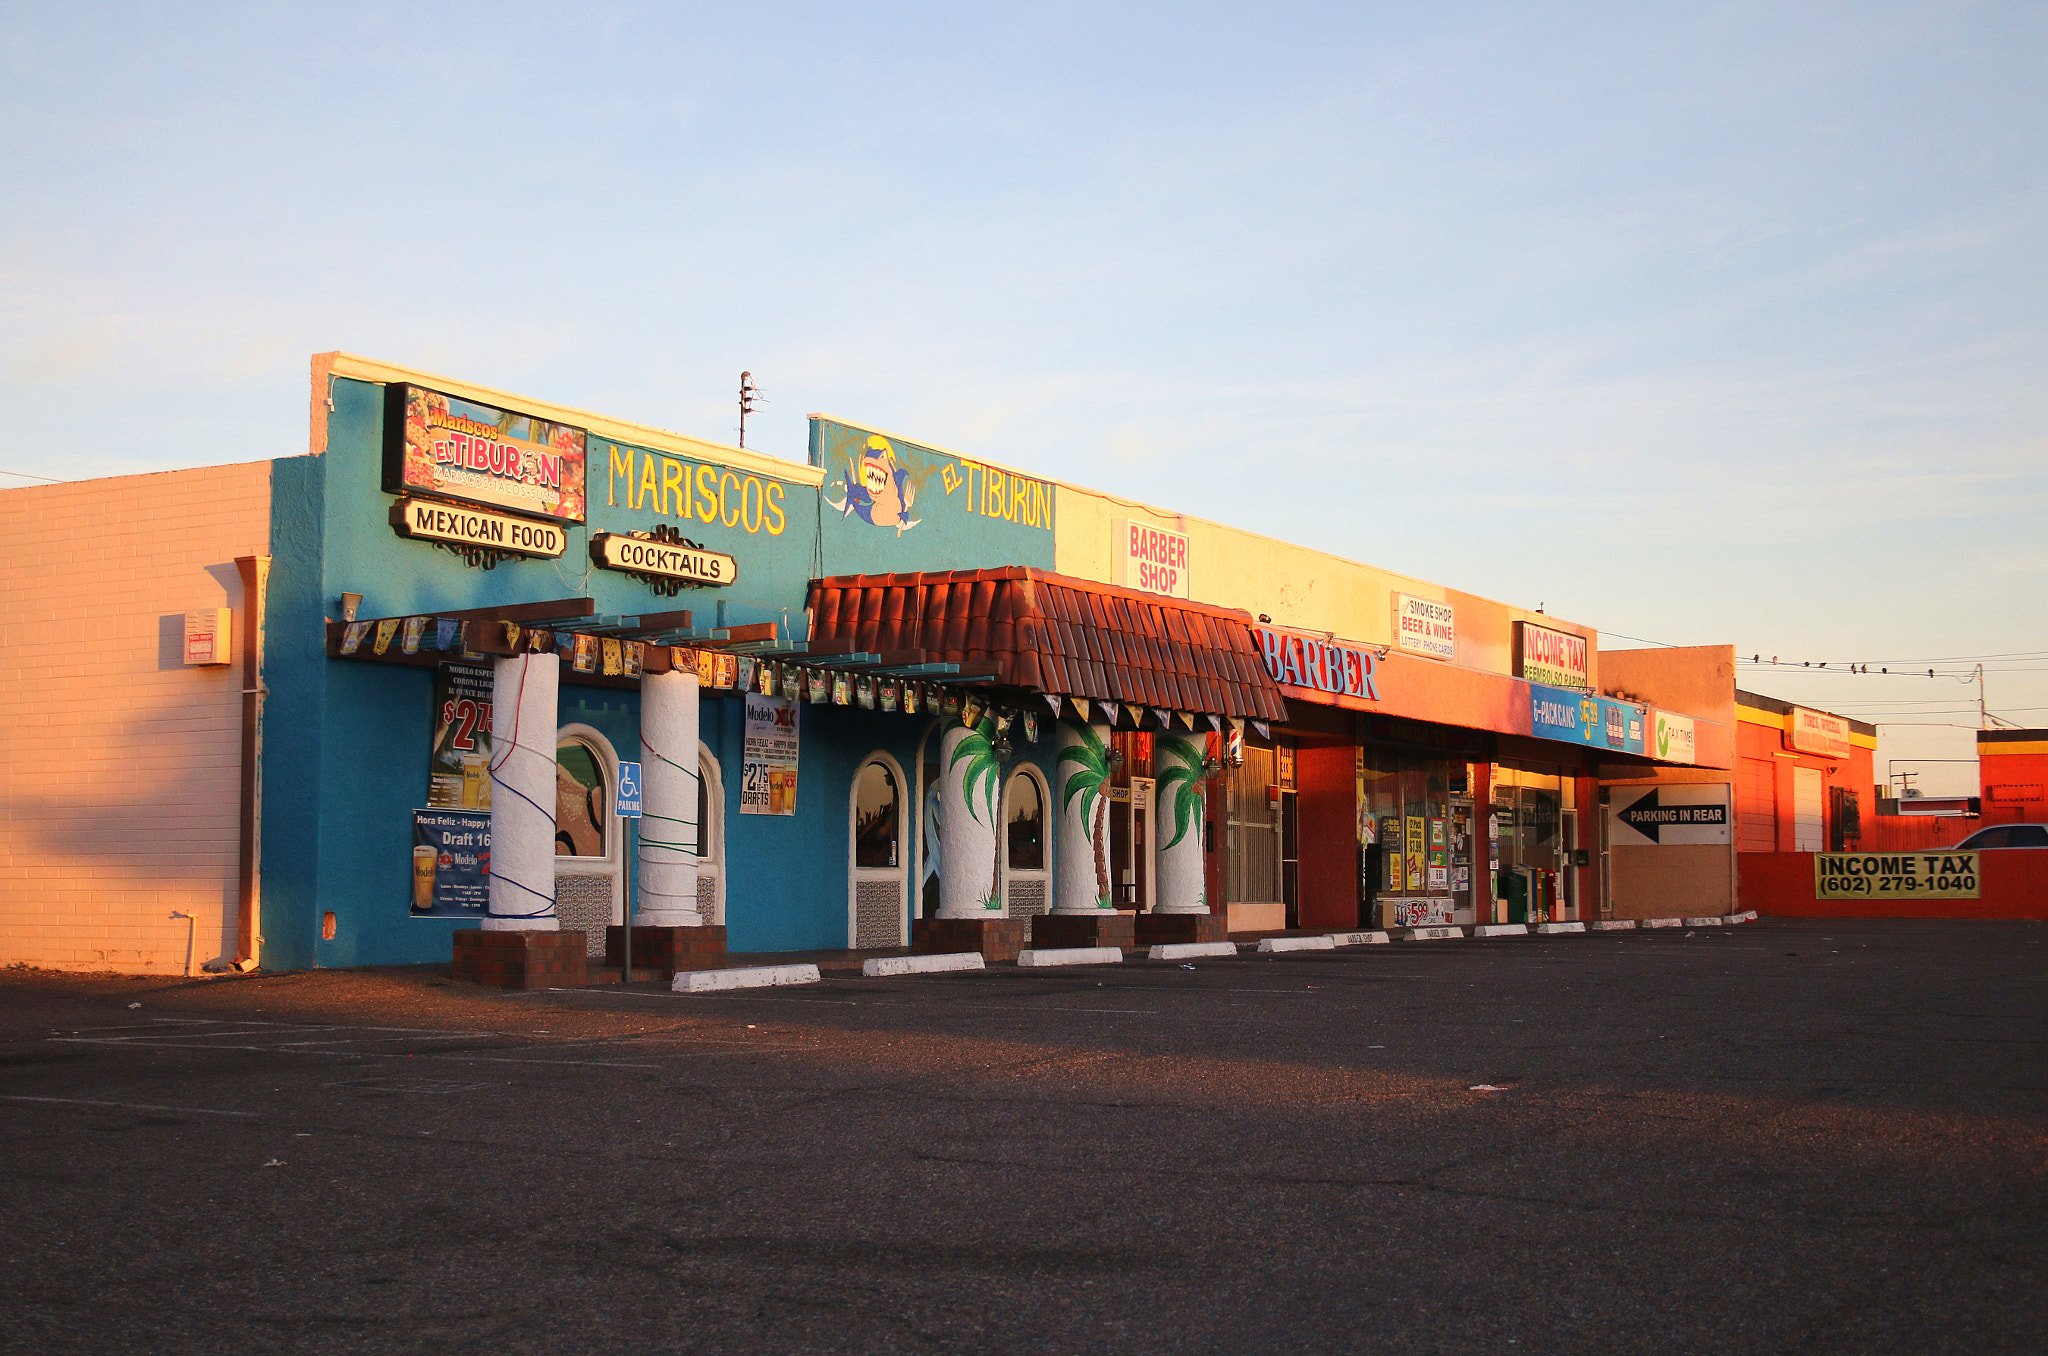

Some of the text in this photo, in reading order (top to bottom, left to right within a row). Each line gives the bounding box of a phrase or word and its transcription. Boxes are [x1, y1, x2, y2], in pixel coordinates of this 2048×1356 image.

[433, 408, 498, 440] Mariscos
[434, 432, 560, 488] EL TIBURN
[434, 467, 560, 505] MARISCOS TACOS SUSHI
[608, 444, 786, 536] MARISCOS
[940, 458, 1052, 530] EL TIBURON
[416, 508, 556, 551] MEXICAN FOOD
[1130, 525, 1186, 569] BARBER
[620, 544, 721, 579] COCKTAILS
[1140, 562, 1177, 593] SHOP
[1409, 600, 1452, 623] SMOKE SHOP
[1402, 616, 1452, 641] BEER & WINE
[1523, 627, 1586, 673] INCOME TAX
[449, 665, 474, 676] MODELO
[1256, 629, 1381, 701] BARBER
[453, 677, 478, 687] CORONA
[1524, 666, 1563, 686] REEMBOLSO
[456, 687, 476, 697] OUNCE
[747, 704, 774, 723] Modelo
[742, 791, 769, 806] DRAFTS
[1112, 789, 1129, 799] SHOP
[618, 800, 640, 812] PARKING
[1630, 809, 1722, 822] PARKING IN REAR
[417, 815, 436, 825] Hora
[437, 816, 456, 826] Feliz
[462, 818, 486, 829] Happy
[442, 832, 491, 846] Draft 16
[454, 852, 478, 866] Modelo
[1820, 856, 1975, 876] INCOME TAX
[1820, 876, 1976, 895] (602) 279-1040
